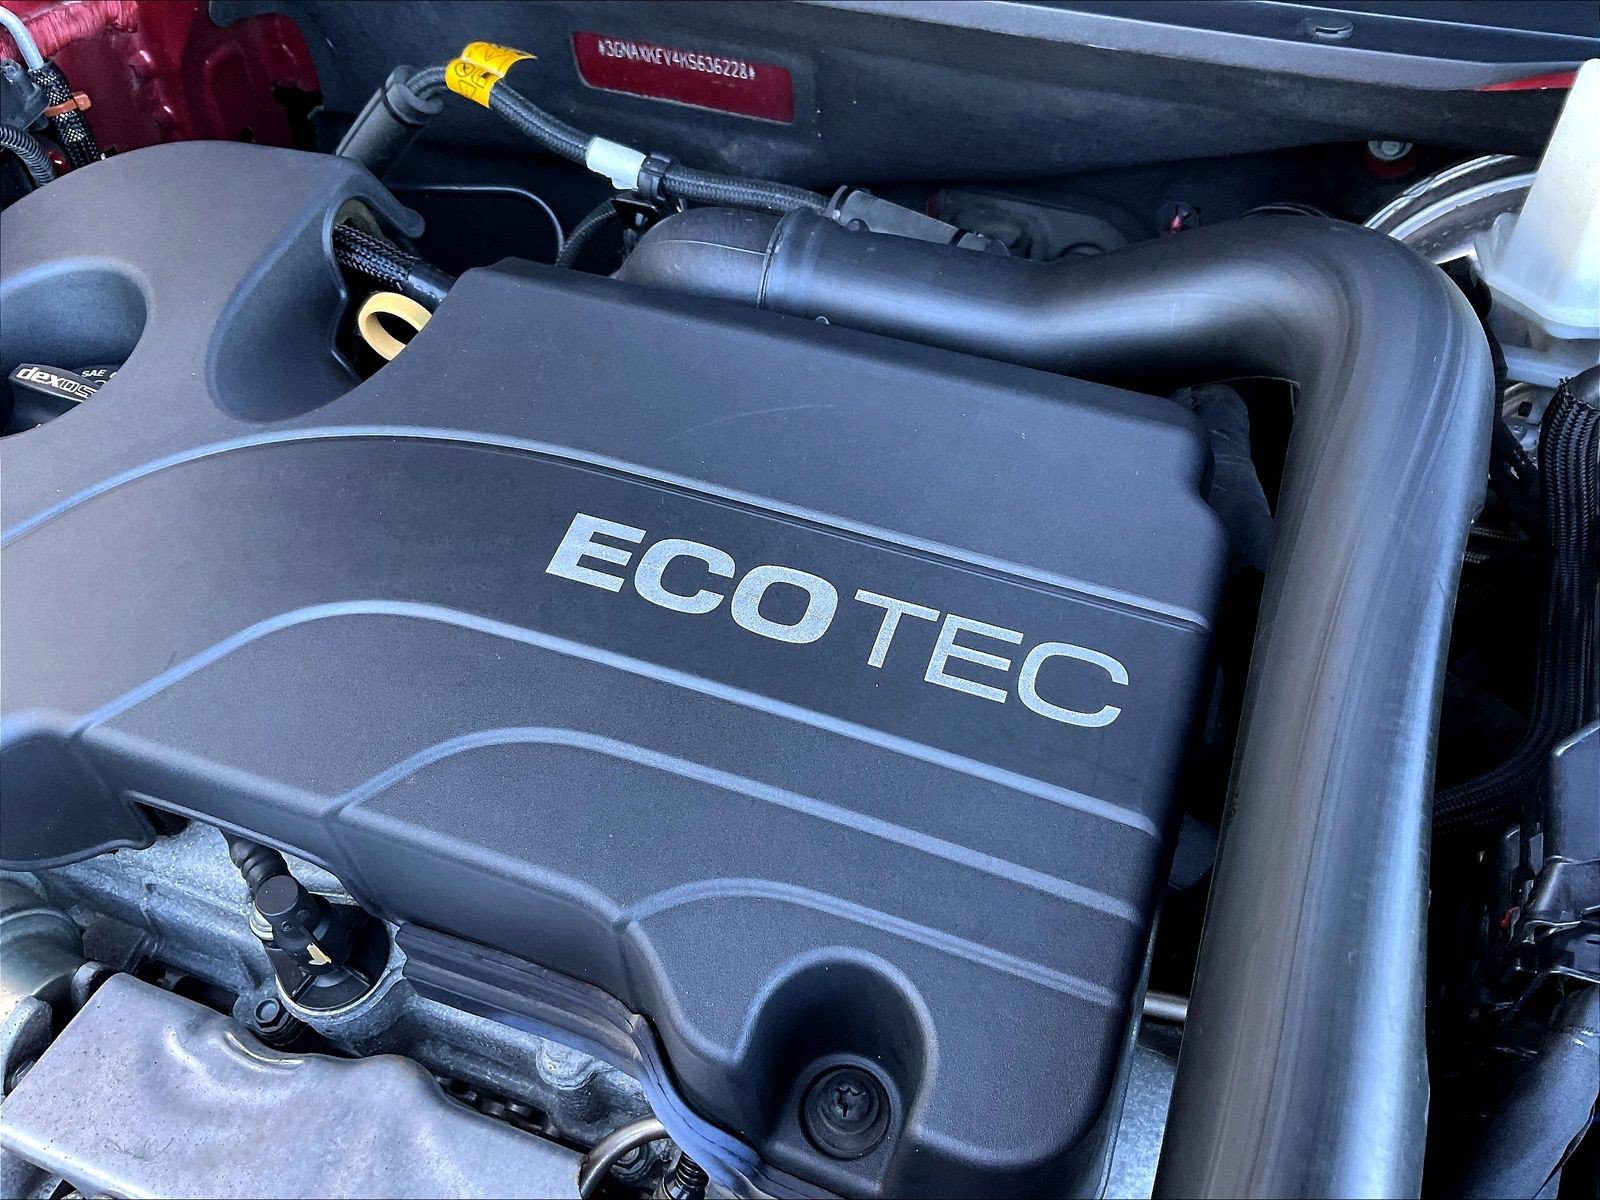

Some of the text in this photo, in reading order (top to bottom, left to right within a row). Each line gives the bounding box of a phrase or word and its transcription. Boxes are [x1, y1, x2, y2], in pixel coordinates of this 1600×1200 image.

[16, 366, 97, 399] dexos
[81, 369, 107, 378] SAE
[545, 512, 1129, 728] ECOTEC
